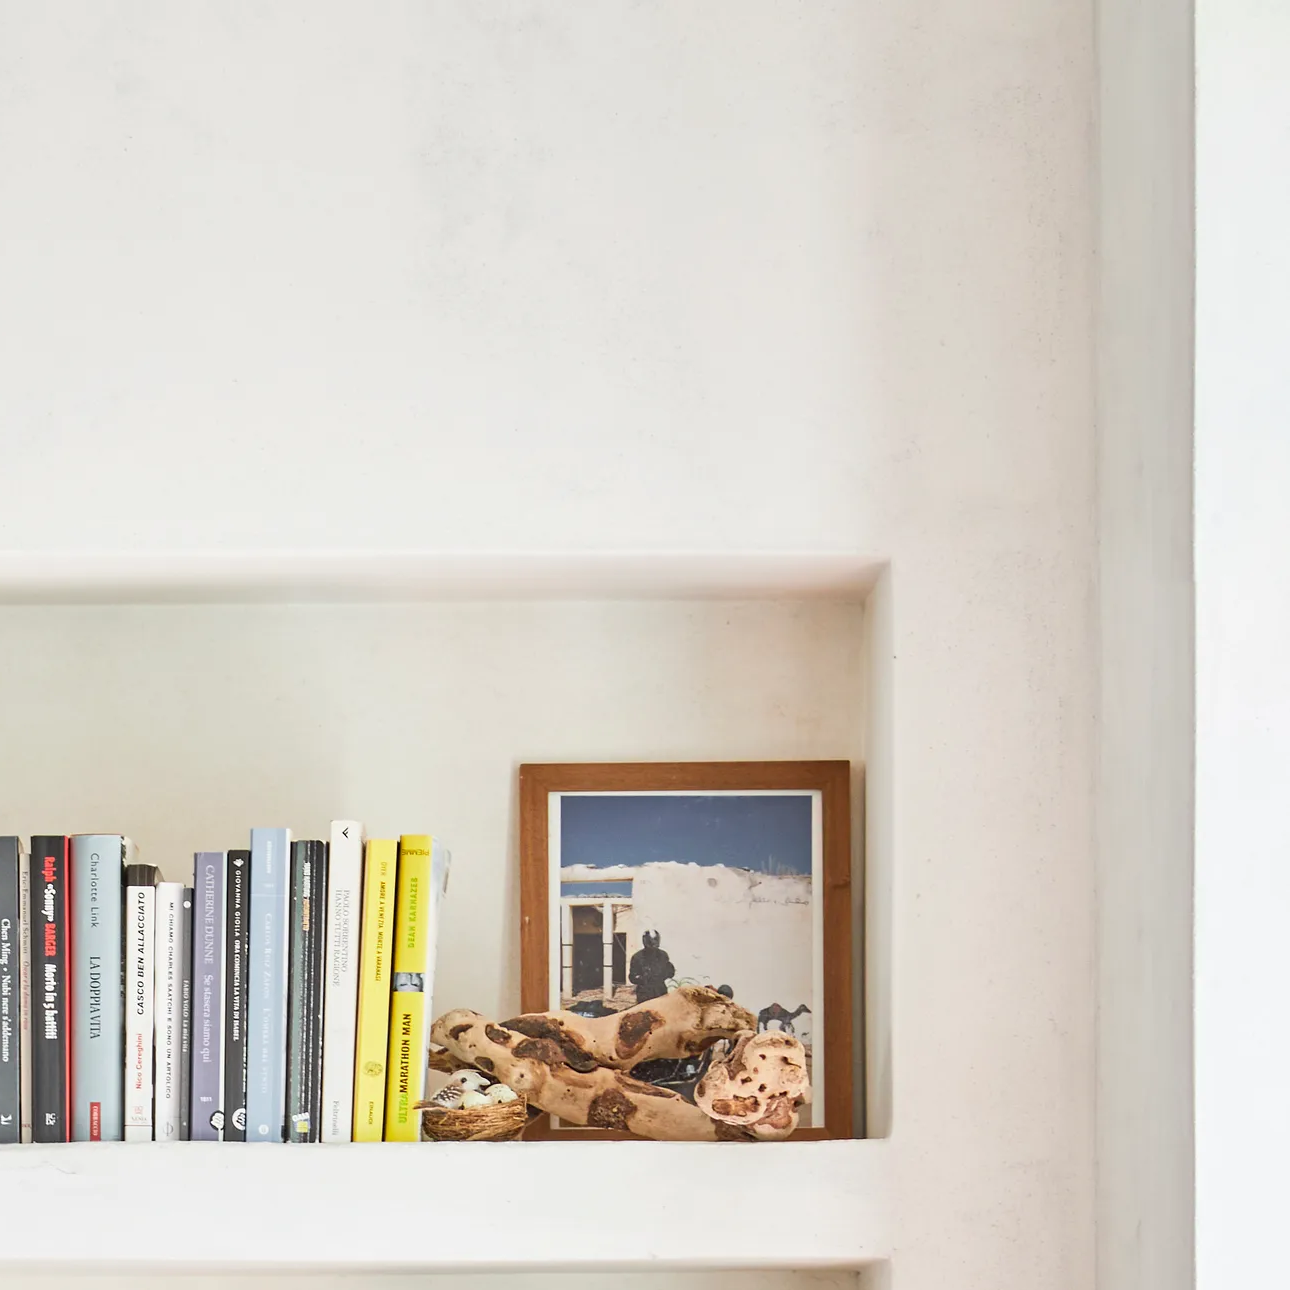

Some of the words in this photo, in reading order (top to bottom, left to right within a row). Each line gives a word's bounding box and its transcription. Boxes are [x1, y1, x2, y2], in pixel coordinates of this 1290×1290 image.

[43, 857, 55, 882] Ralph
[91, 853, 99, 902] Charlotte
[169, 902, 174, 911] MI
[204, 865, 215, 924] CATHERINE
[334, 889, 342, 920] HANNO
[341, 890, 349, 915] PAOLO
[1, 919, 10, 941] Chen
[91, 907, 100, 928] Link
[44, 923, 56, 956] BARGER
[204, 925, 214, 964] DUNNE
[333, 921, 341, 946] TUTTI
[341, 917, 349, 972] SORRENTINO
[407, 926, 416, 948] DEAN
[0, 943, 10, 965] Ming
[90, 956, 101, 970] LA
[44, 964, 58, 991] Morto
[203, 975, 213, 985] Se
[332, 949, 341, 987] RAGIONE
[2, 975, 11, 995] Nubi
[45, 993, 57, 1002] in
[90, 972, 101, 1012] DOPPIA
[136, 981, 144, 1015] CASCO
[234, 987, 240, 996] LA
[203, 987, 212, 1018] stasera
[45, 1010, 58, 1039] battiti
[90, 1013, 101, 1039] VITA
[202, 1019, 212, 1045] siamo
[401, 1014, 411, 1035] MAN
[1, 1016, 11, 1062] s'addensano
[135, 1033, 144, 1069] Cereghini
[166, 1049, 171, 1059] UN
[200, 1047, 212, 1063] qui
[331, 1100, 339, 1136] Feltrinelli
